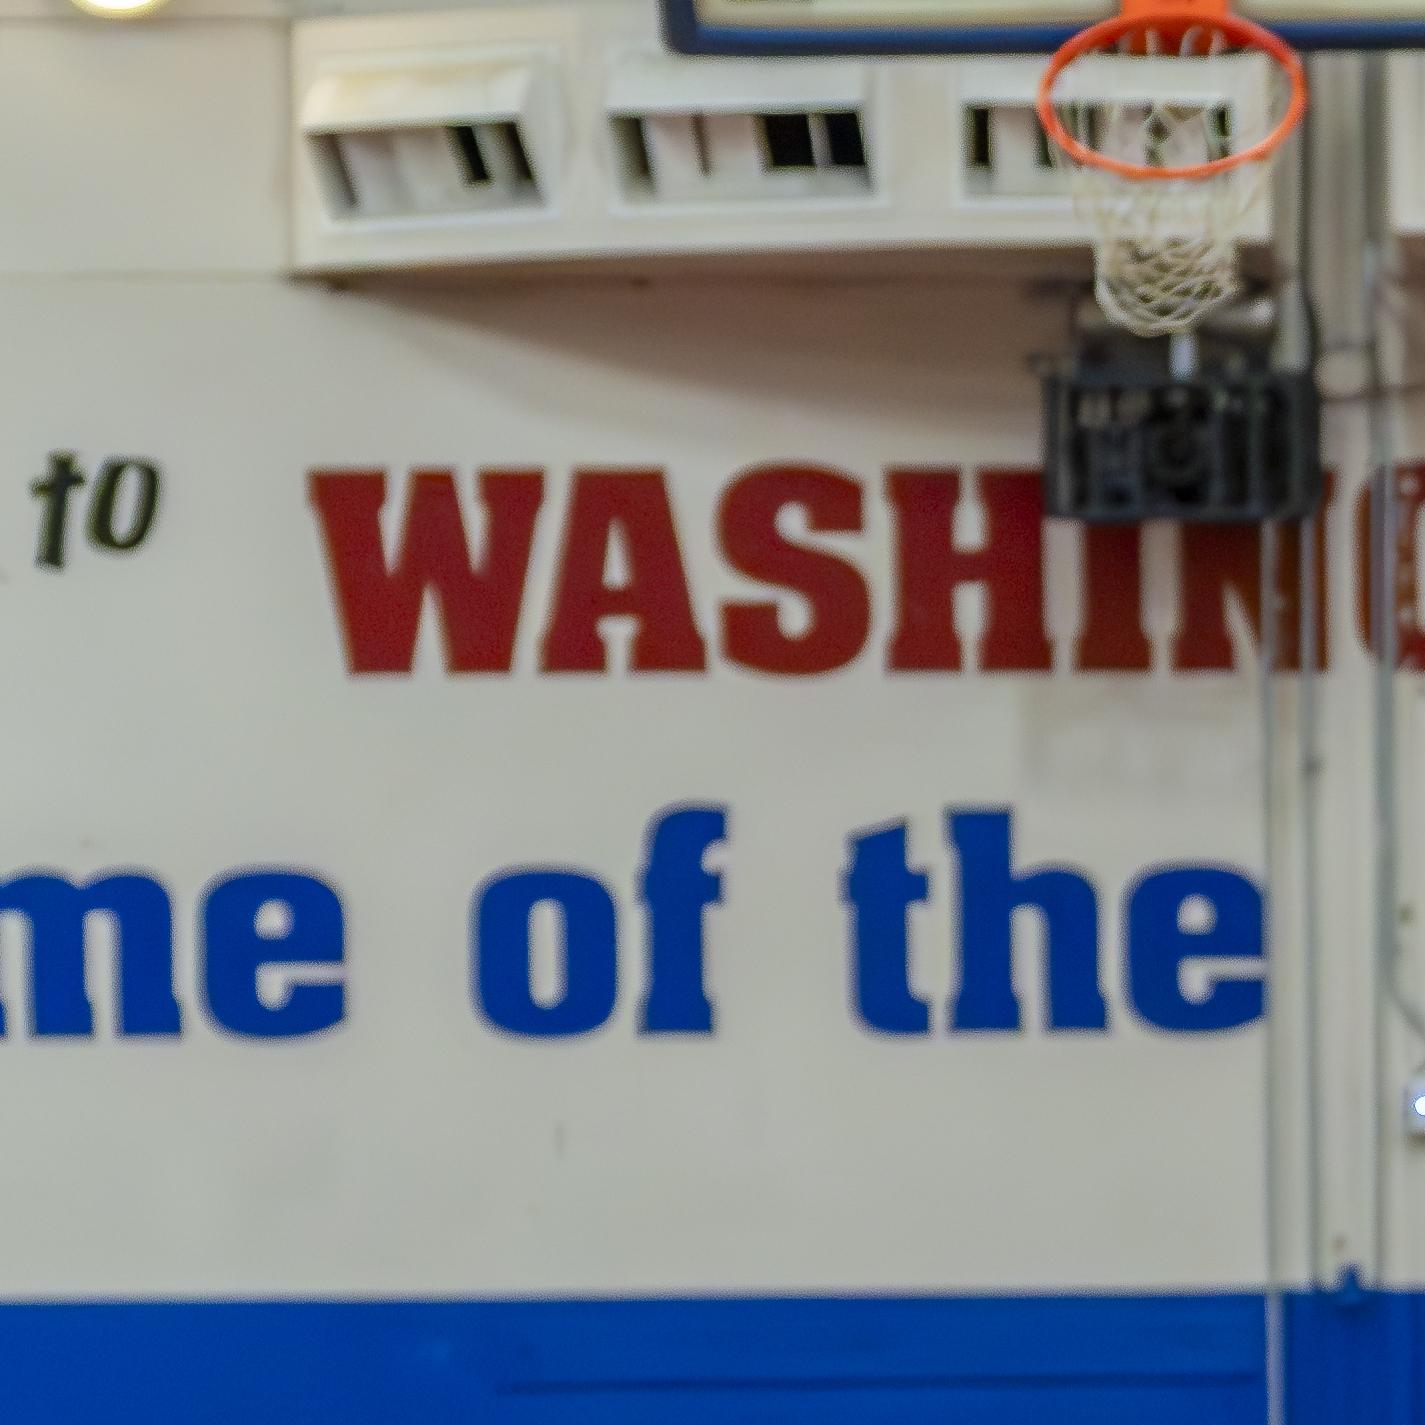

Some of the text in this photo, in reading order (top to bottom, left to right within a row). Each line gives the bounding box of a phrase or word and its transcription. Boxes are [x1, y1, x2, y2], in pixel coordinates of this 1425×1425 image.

[32, 453, 161, 570] to
[473, 805, 728, 1039] of
[843, 808, 1267, 1037] the
